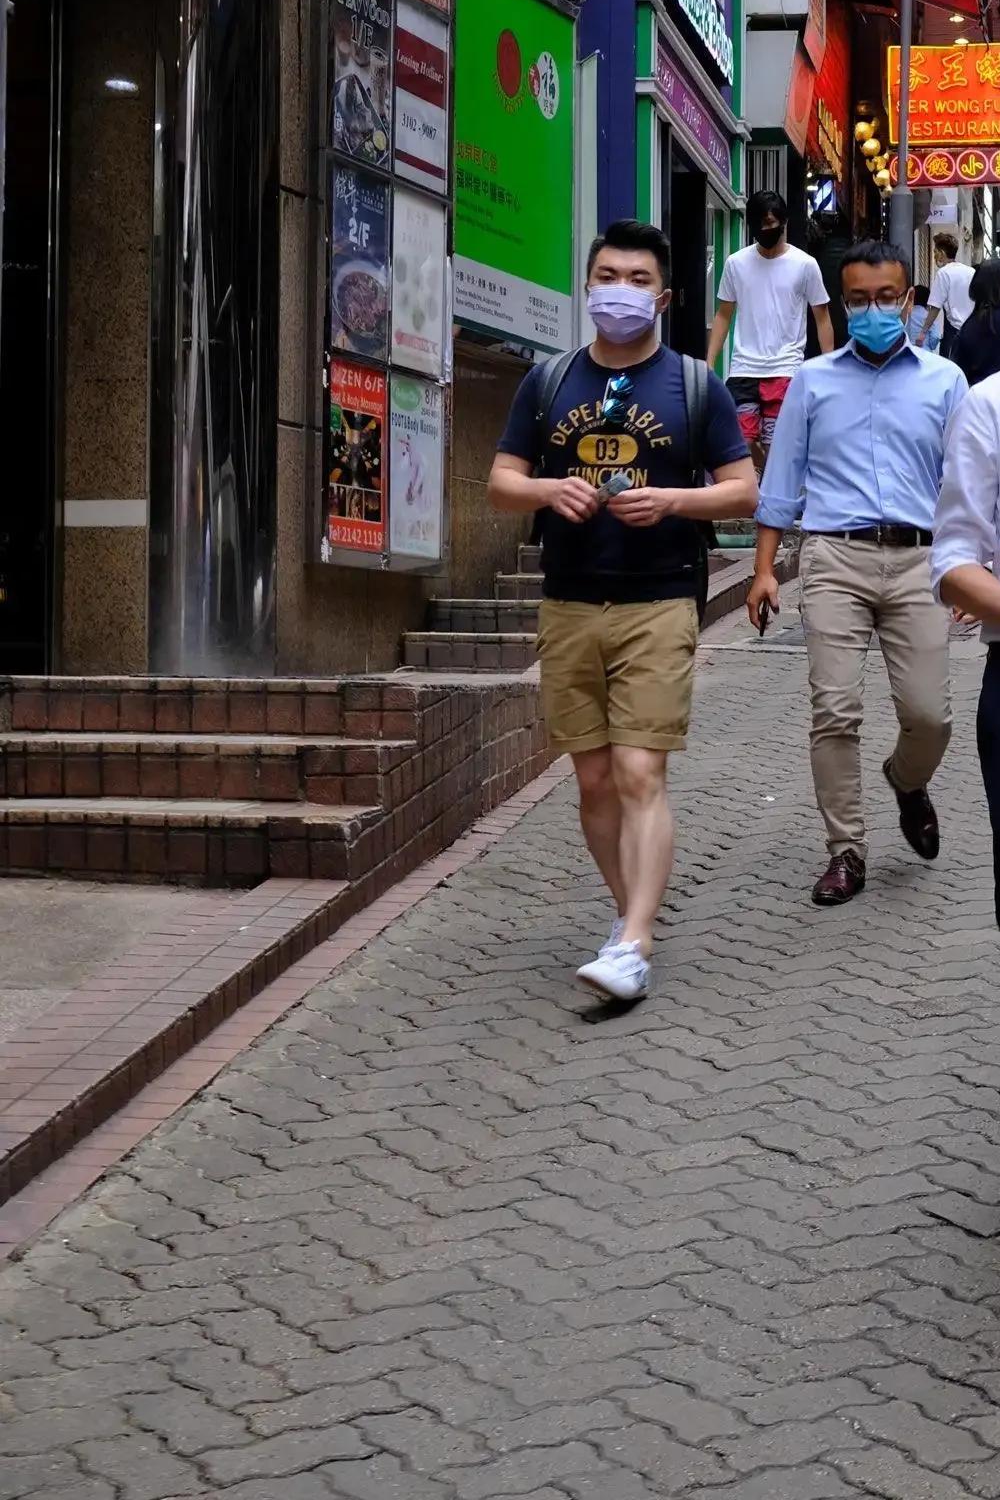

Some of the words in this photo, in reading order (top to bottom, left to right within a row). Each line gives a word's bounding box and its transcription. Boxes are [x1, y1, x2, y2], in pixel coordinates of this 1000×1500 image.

[397, 49, 420, 77] Leasing
[420, 58, 445, 84] Hotline:
[934, 100, 980, 114] WONG
[348, 216, 371, 249] 2/F
[340, 367, 362, 390] ZEN
[364, 374, 383, 393] 6/F
[595, 438, 620, 461] 03
